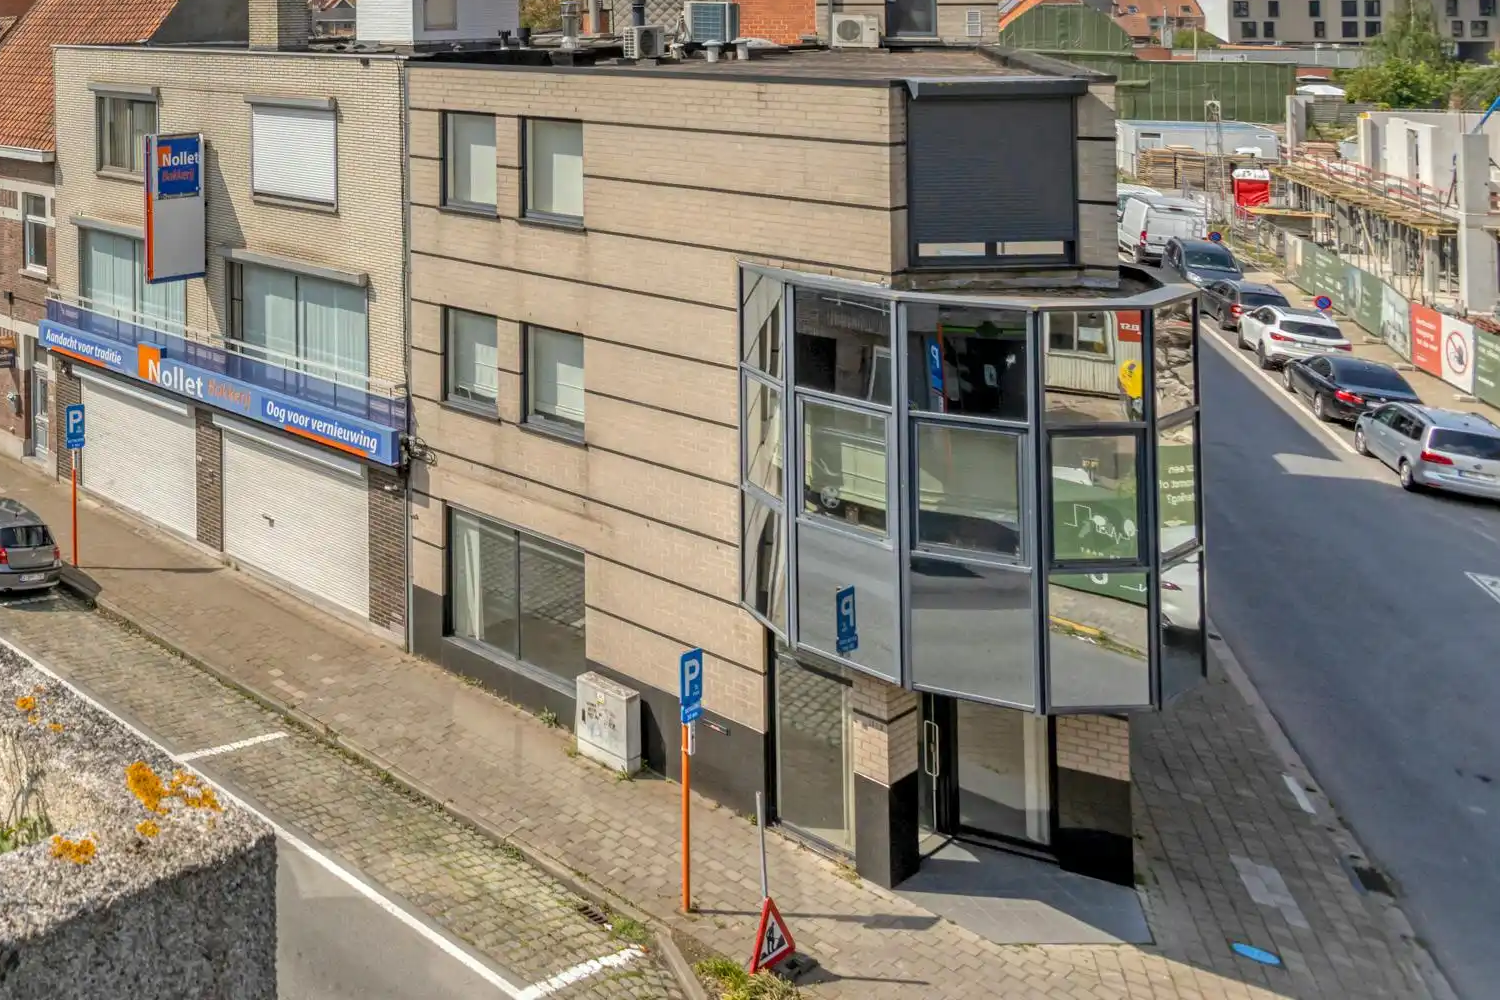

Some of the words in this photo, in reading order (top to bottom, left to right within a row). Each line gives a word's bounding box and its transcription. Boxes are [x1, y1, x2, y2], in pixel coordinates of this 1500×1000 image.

[162, 151, 201, 167] Nollet
[46, 329, 77, 350] Aandacht
[77, 342, 94, 355] voor
[95, 348, 122, 365] traditie
[148, 359, 204, 398] Nollet
[207, 378, 251, 411] Bakkerij
[69, 410, 83, 433] P
[266, 400, 286, 423] Oog
[287, 410, 311, 427] voor
[311, 417, 378, 453] vernieuwing
[685, 659, 700, 697] P
